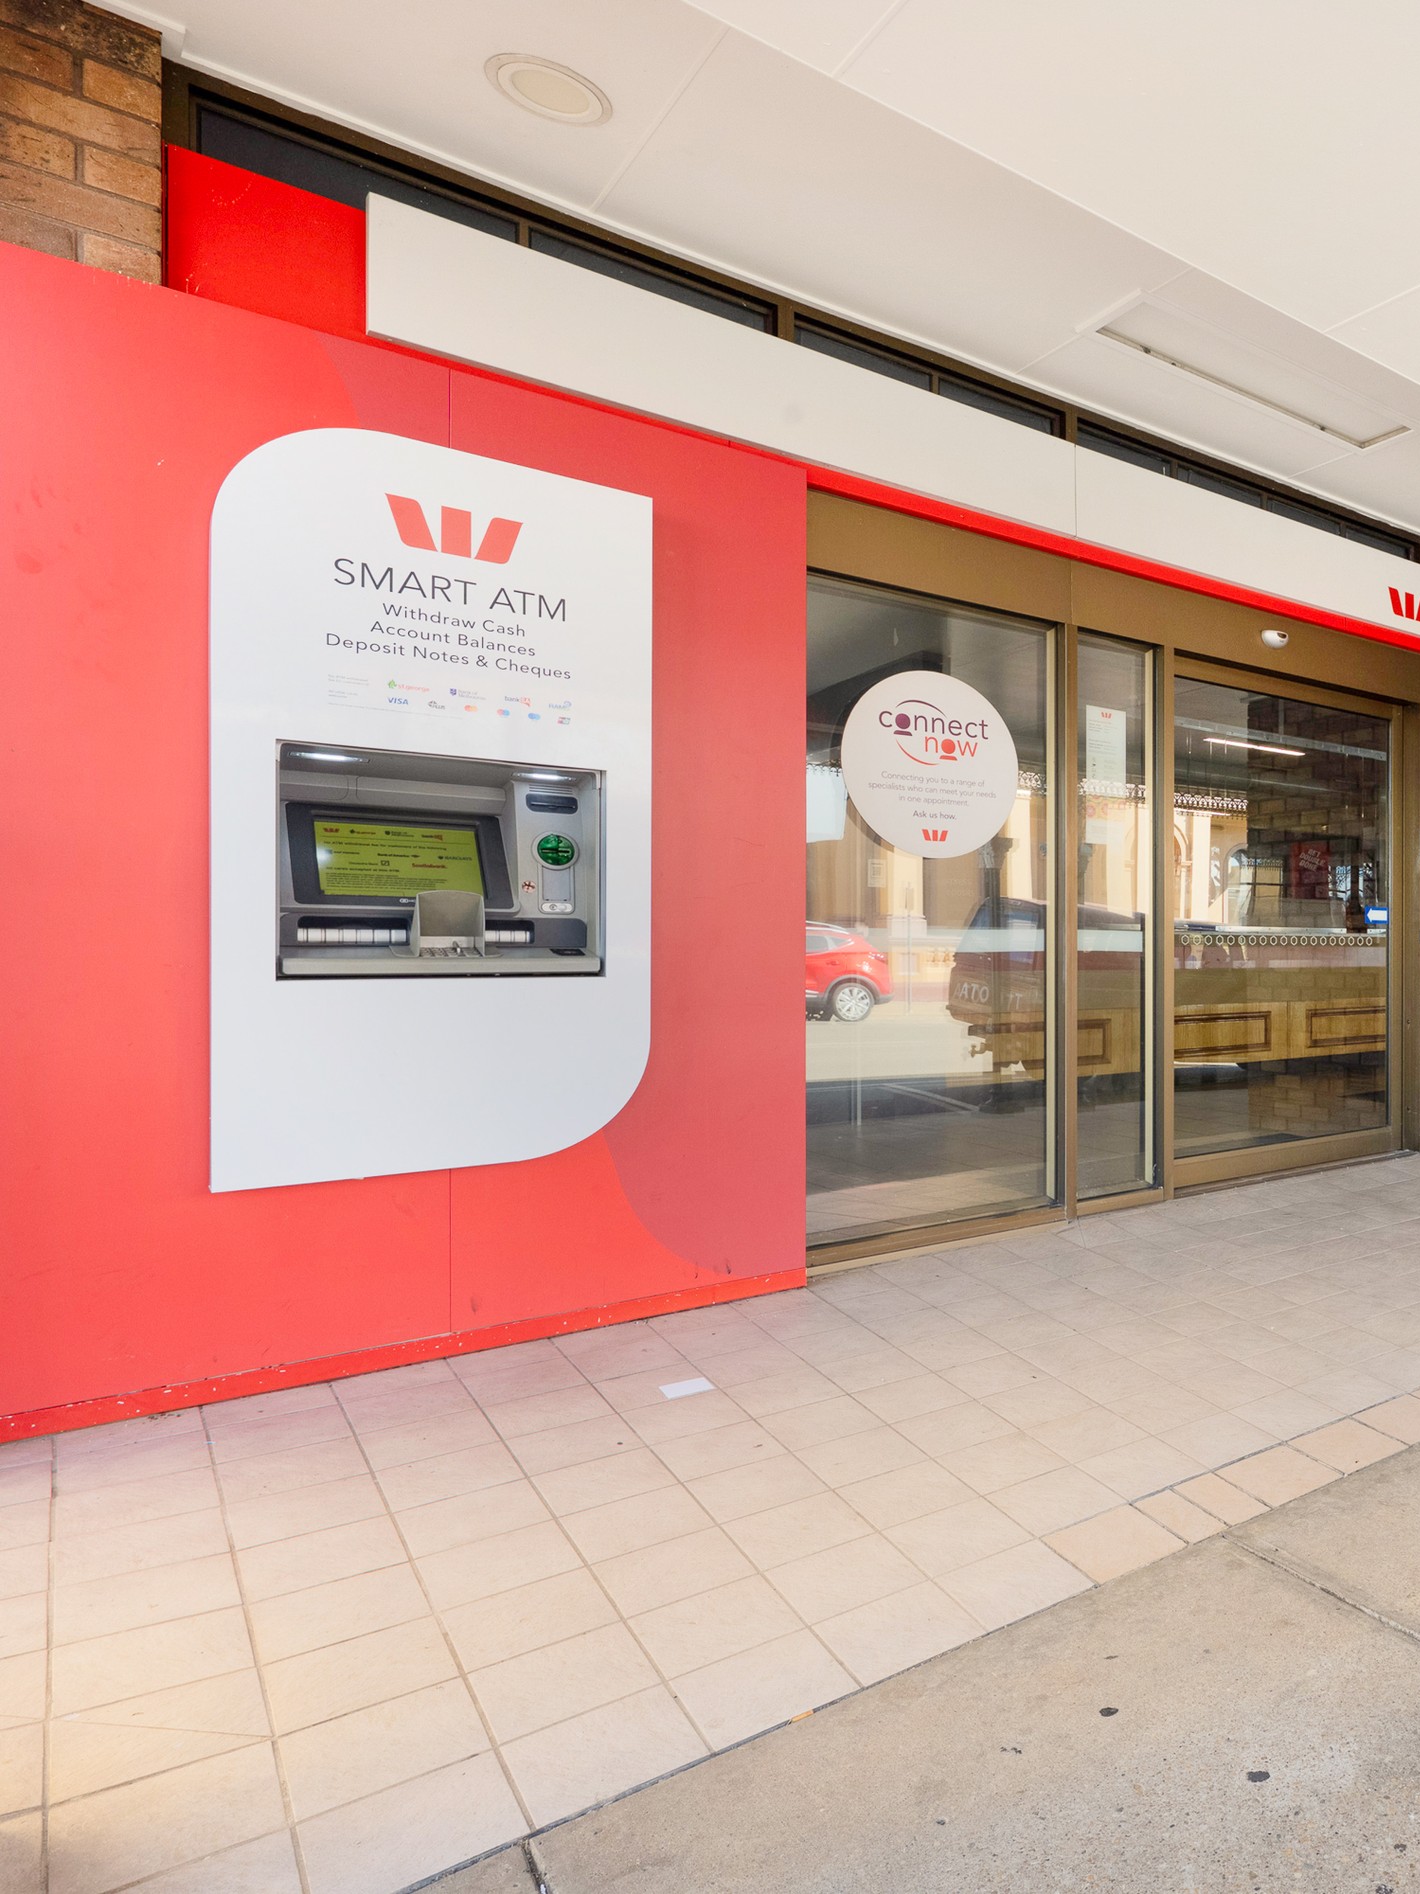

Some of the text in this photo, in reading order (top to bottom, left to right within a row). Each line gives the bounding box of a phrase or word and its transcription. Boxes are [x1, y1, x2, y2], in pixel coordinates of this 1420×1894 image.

[334, 558, 567, 622] SMART ATM
[382, 602, 526, 637] Withdraw Cash
[370, 620, 536, 657] Account Balances
[326, 633, 572, 680] Deposit Notes & Cheques
[388, 697, 409, 705] VISA
[878, 710, 989, 740] connect
[924, 736, 978, 761] now
[868, 781, 905, 792] specialists
[939, 787, 957, 795] meet
[959, 789, 974, 798] your
[976, 790, 997, 799] needs
[881, 770, 924, 784] Connecting
[926, 777, 939, 785] you
[940, 777, 948, 785] to
[956, 780, 976, 788] range
[923, 796, 970, 806] appointment.
[913, 810, 927, 819] Ask
[940, 811, 957, 820] how.
